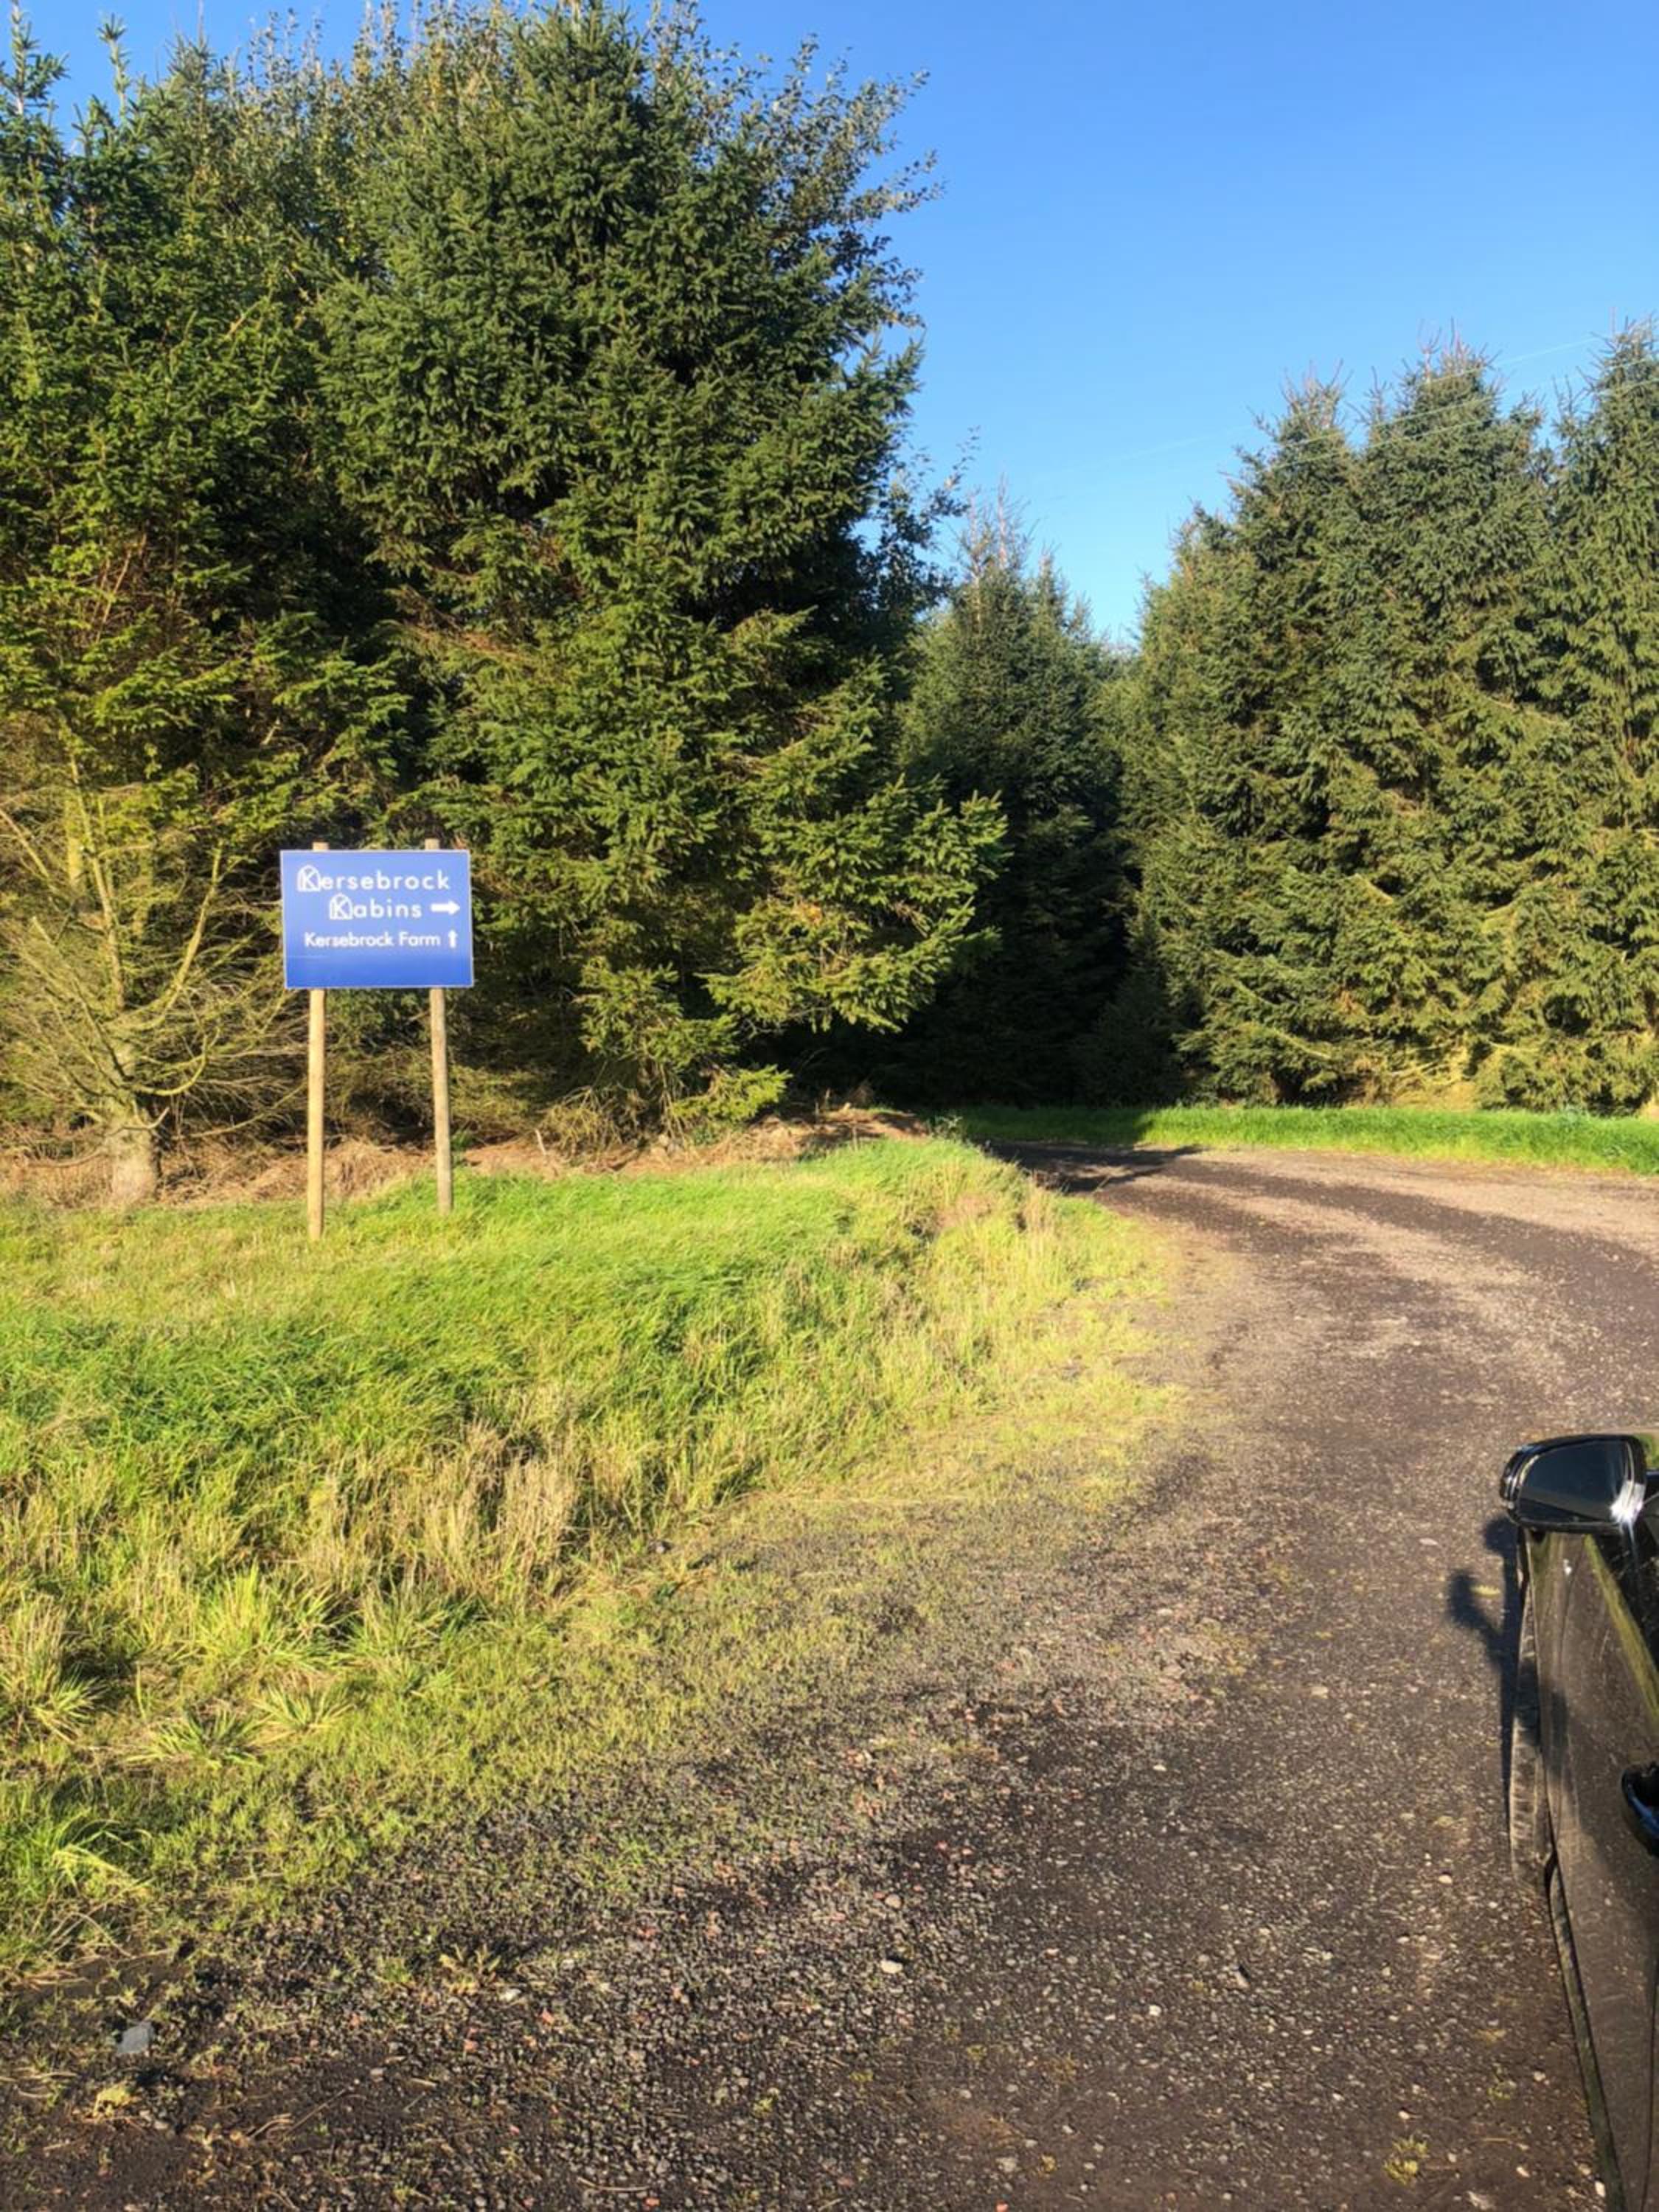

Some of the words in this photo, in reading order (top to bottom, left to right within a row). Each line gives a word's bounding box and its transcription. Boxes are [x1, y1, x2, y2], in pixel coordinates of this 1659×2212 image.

[297, 865, 451, 891] Kersebrock
[329, 893, 422, 919] Kabins
[304, 932, 394, 947] Kersebrock
[398, 931, 440, 947] Farm
